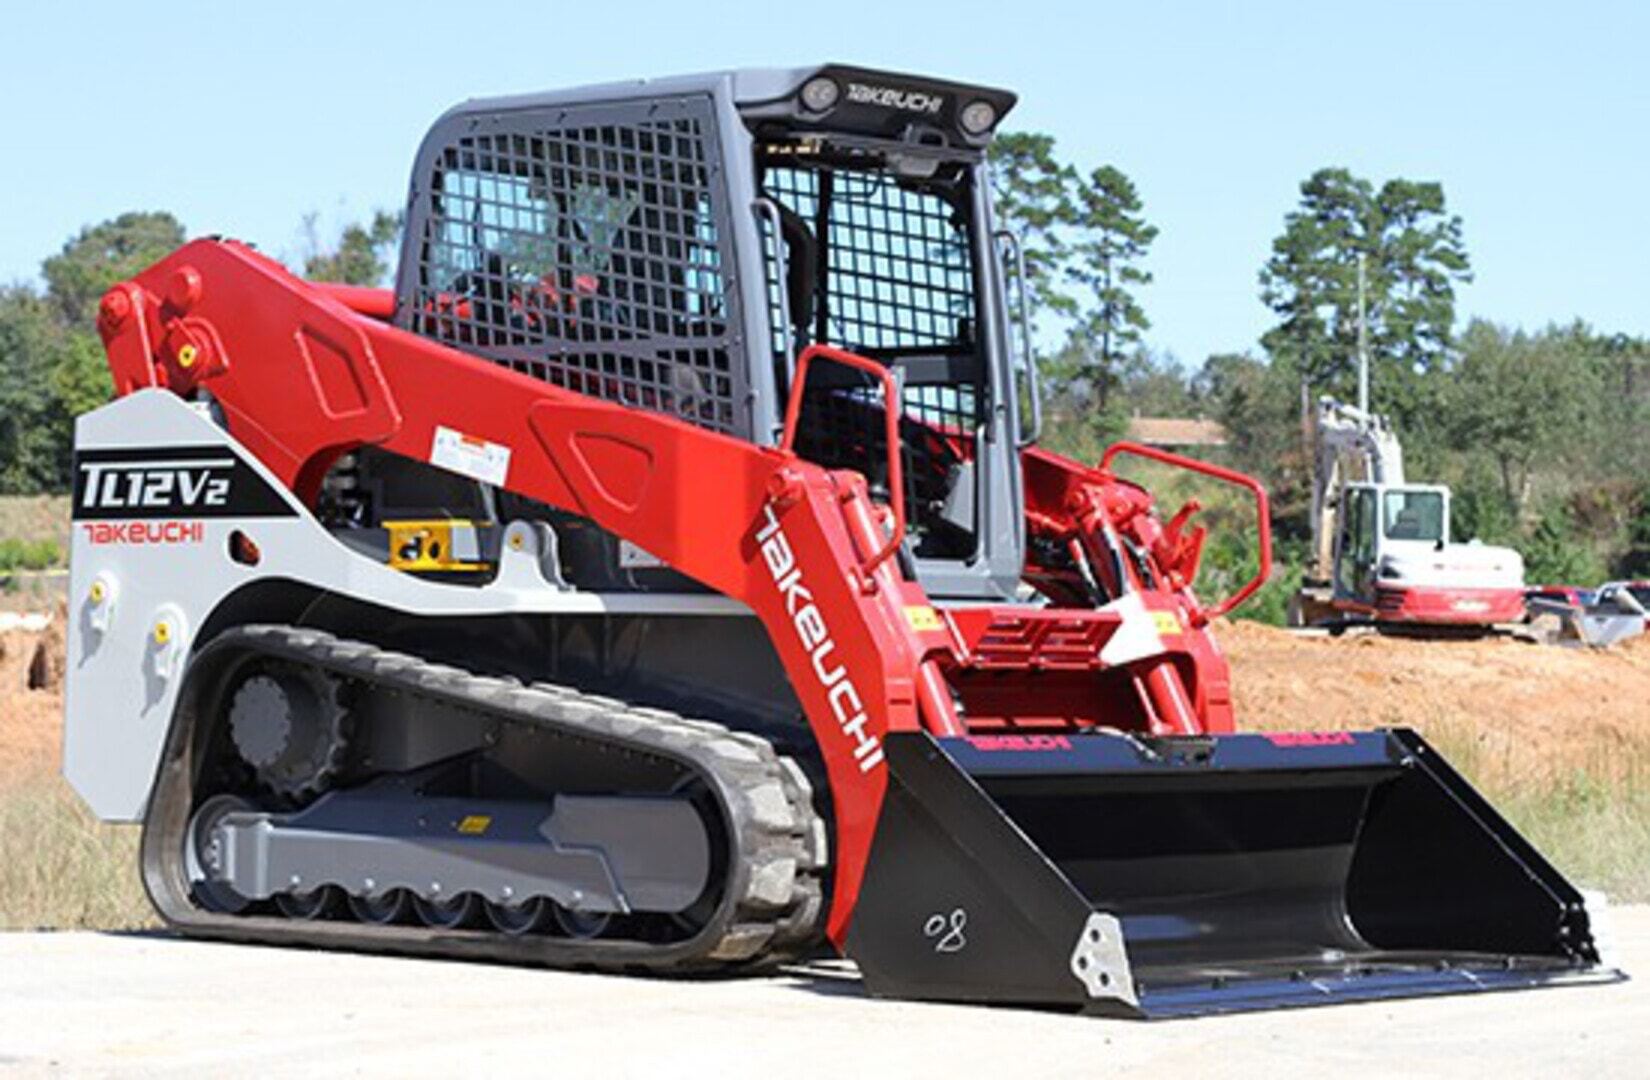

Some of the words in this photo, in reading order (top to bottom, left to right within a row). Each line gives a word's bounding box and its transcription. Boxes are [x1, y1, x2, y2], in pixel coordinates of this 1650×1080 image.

[846, 83, 942, 113] TAKEUCHI
[83, 521, 204, 544] TAKEUCHI
[755, 503, 886, 773] TAKEUCHI
[964, 734, 1073, 752] TUCHI
[924, 908, 967, 952] 08
